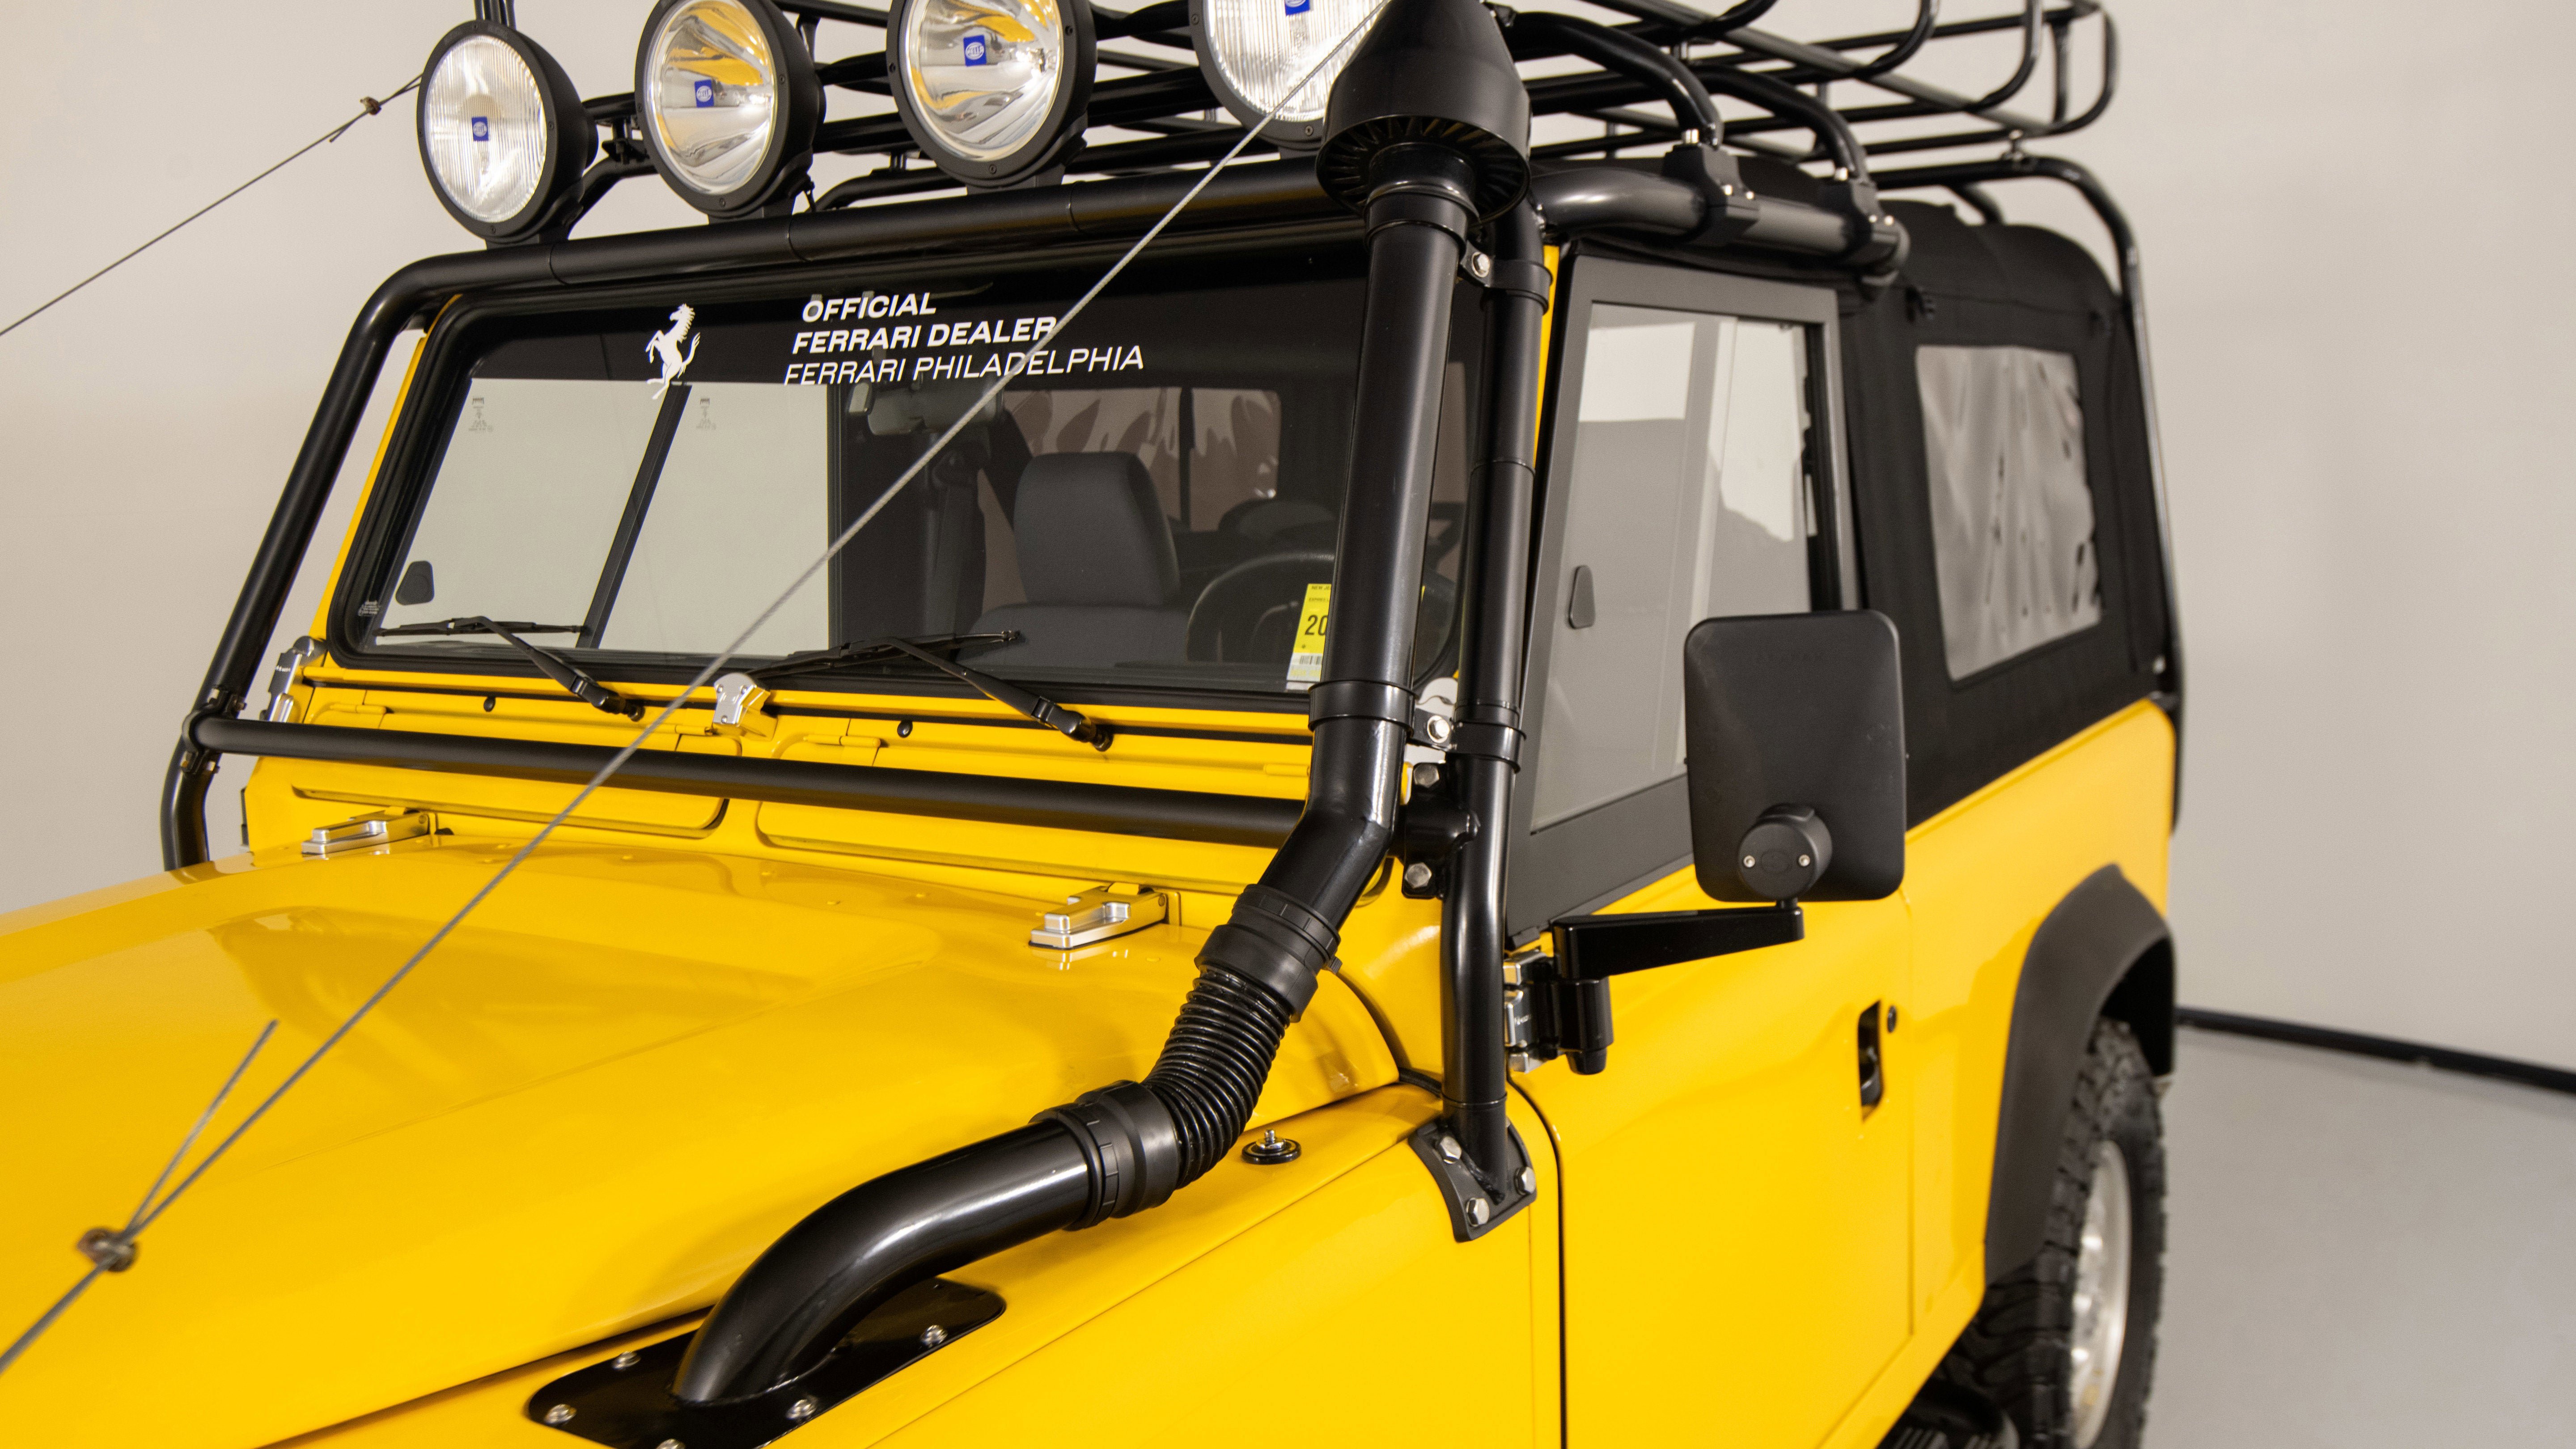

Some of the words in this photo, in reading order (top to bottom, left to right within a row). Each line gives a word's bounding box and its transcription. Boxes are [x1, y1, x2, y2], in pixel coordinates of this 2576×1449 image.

[802, 292, 936, 323] OFFICIAL
[792, 325, 921, 354] FERRARI
[927, 316, 1057, 347] DEALER
[784, 358, 905, 386] FERRARI
[912, 345, 1144, 381] PHILADELPHIA
[1305, 614, 1328, 636] 20
